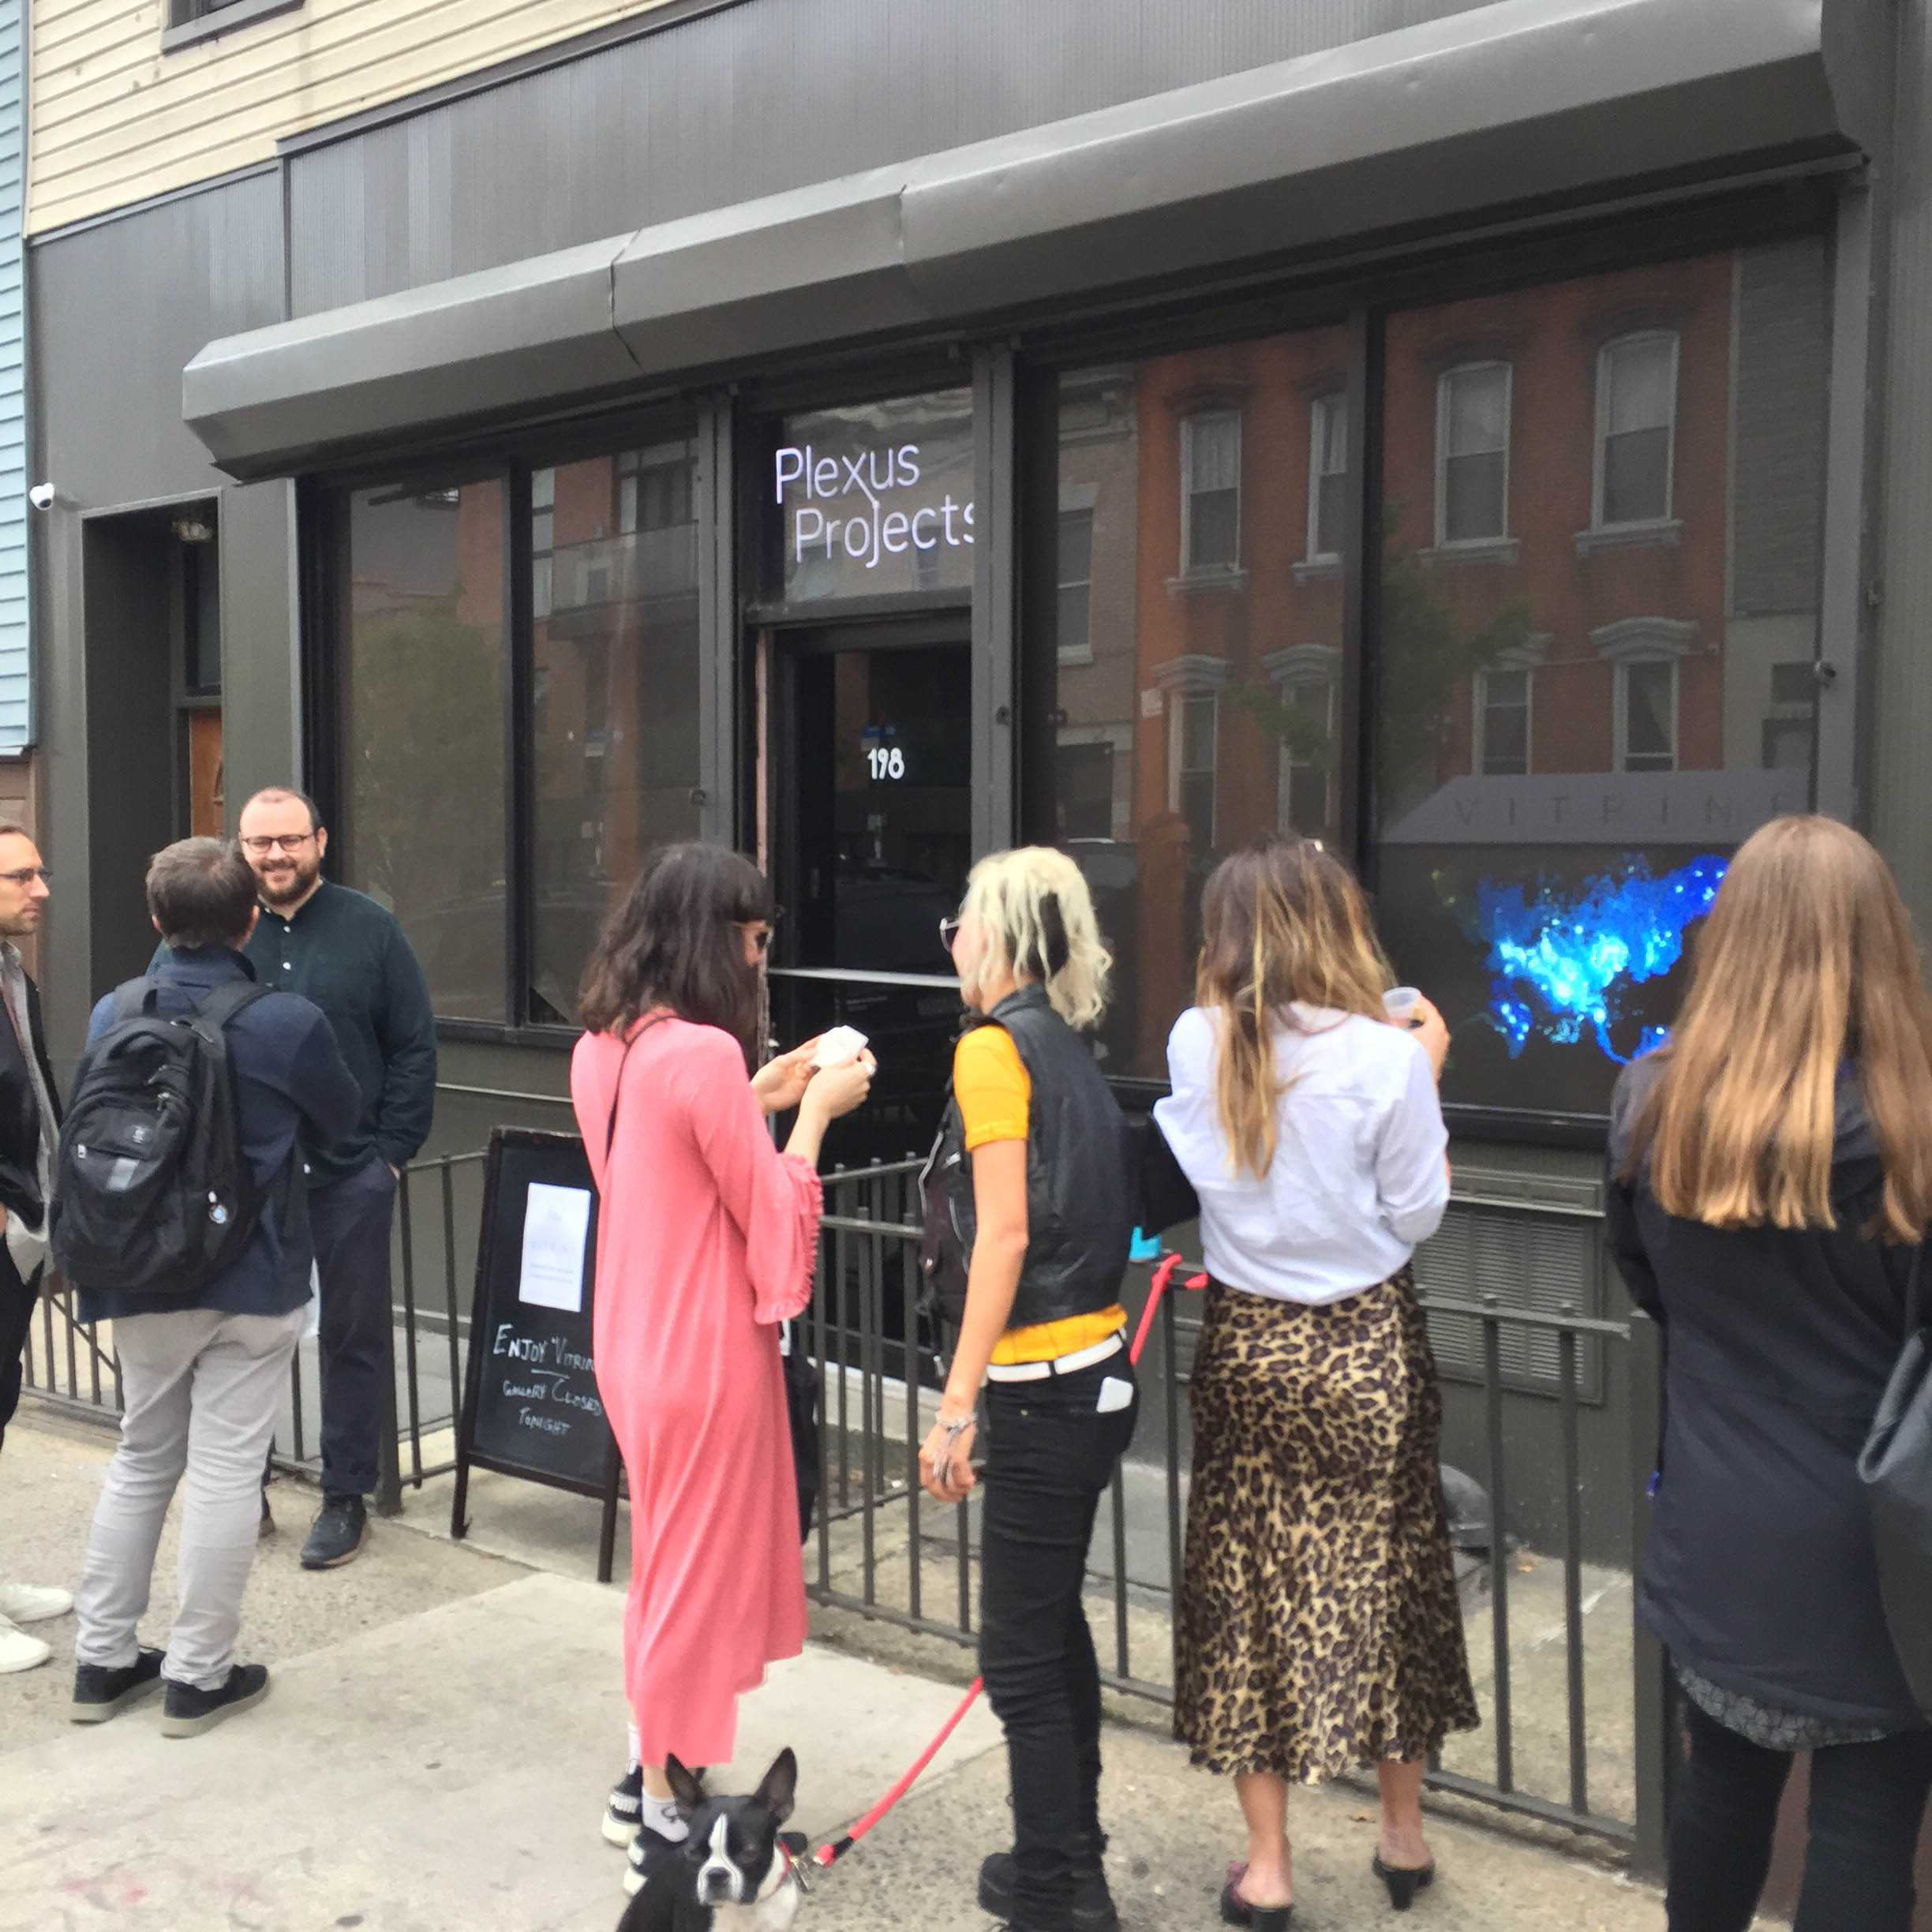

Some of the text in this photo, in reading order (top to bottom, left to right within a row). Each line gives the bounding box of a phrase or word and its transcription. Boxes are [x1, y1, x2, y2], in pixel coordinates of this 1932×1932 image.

[776, 444, 920, 504] Plexus
[867, 747, 905, 780] 198
[492, 1324, 548, 1363] ENJOY
